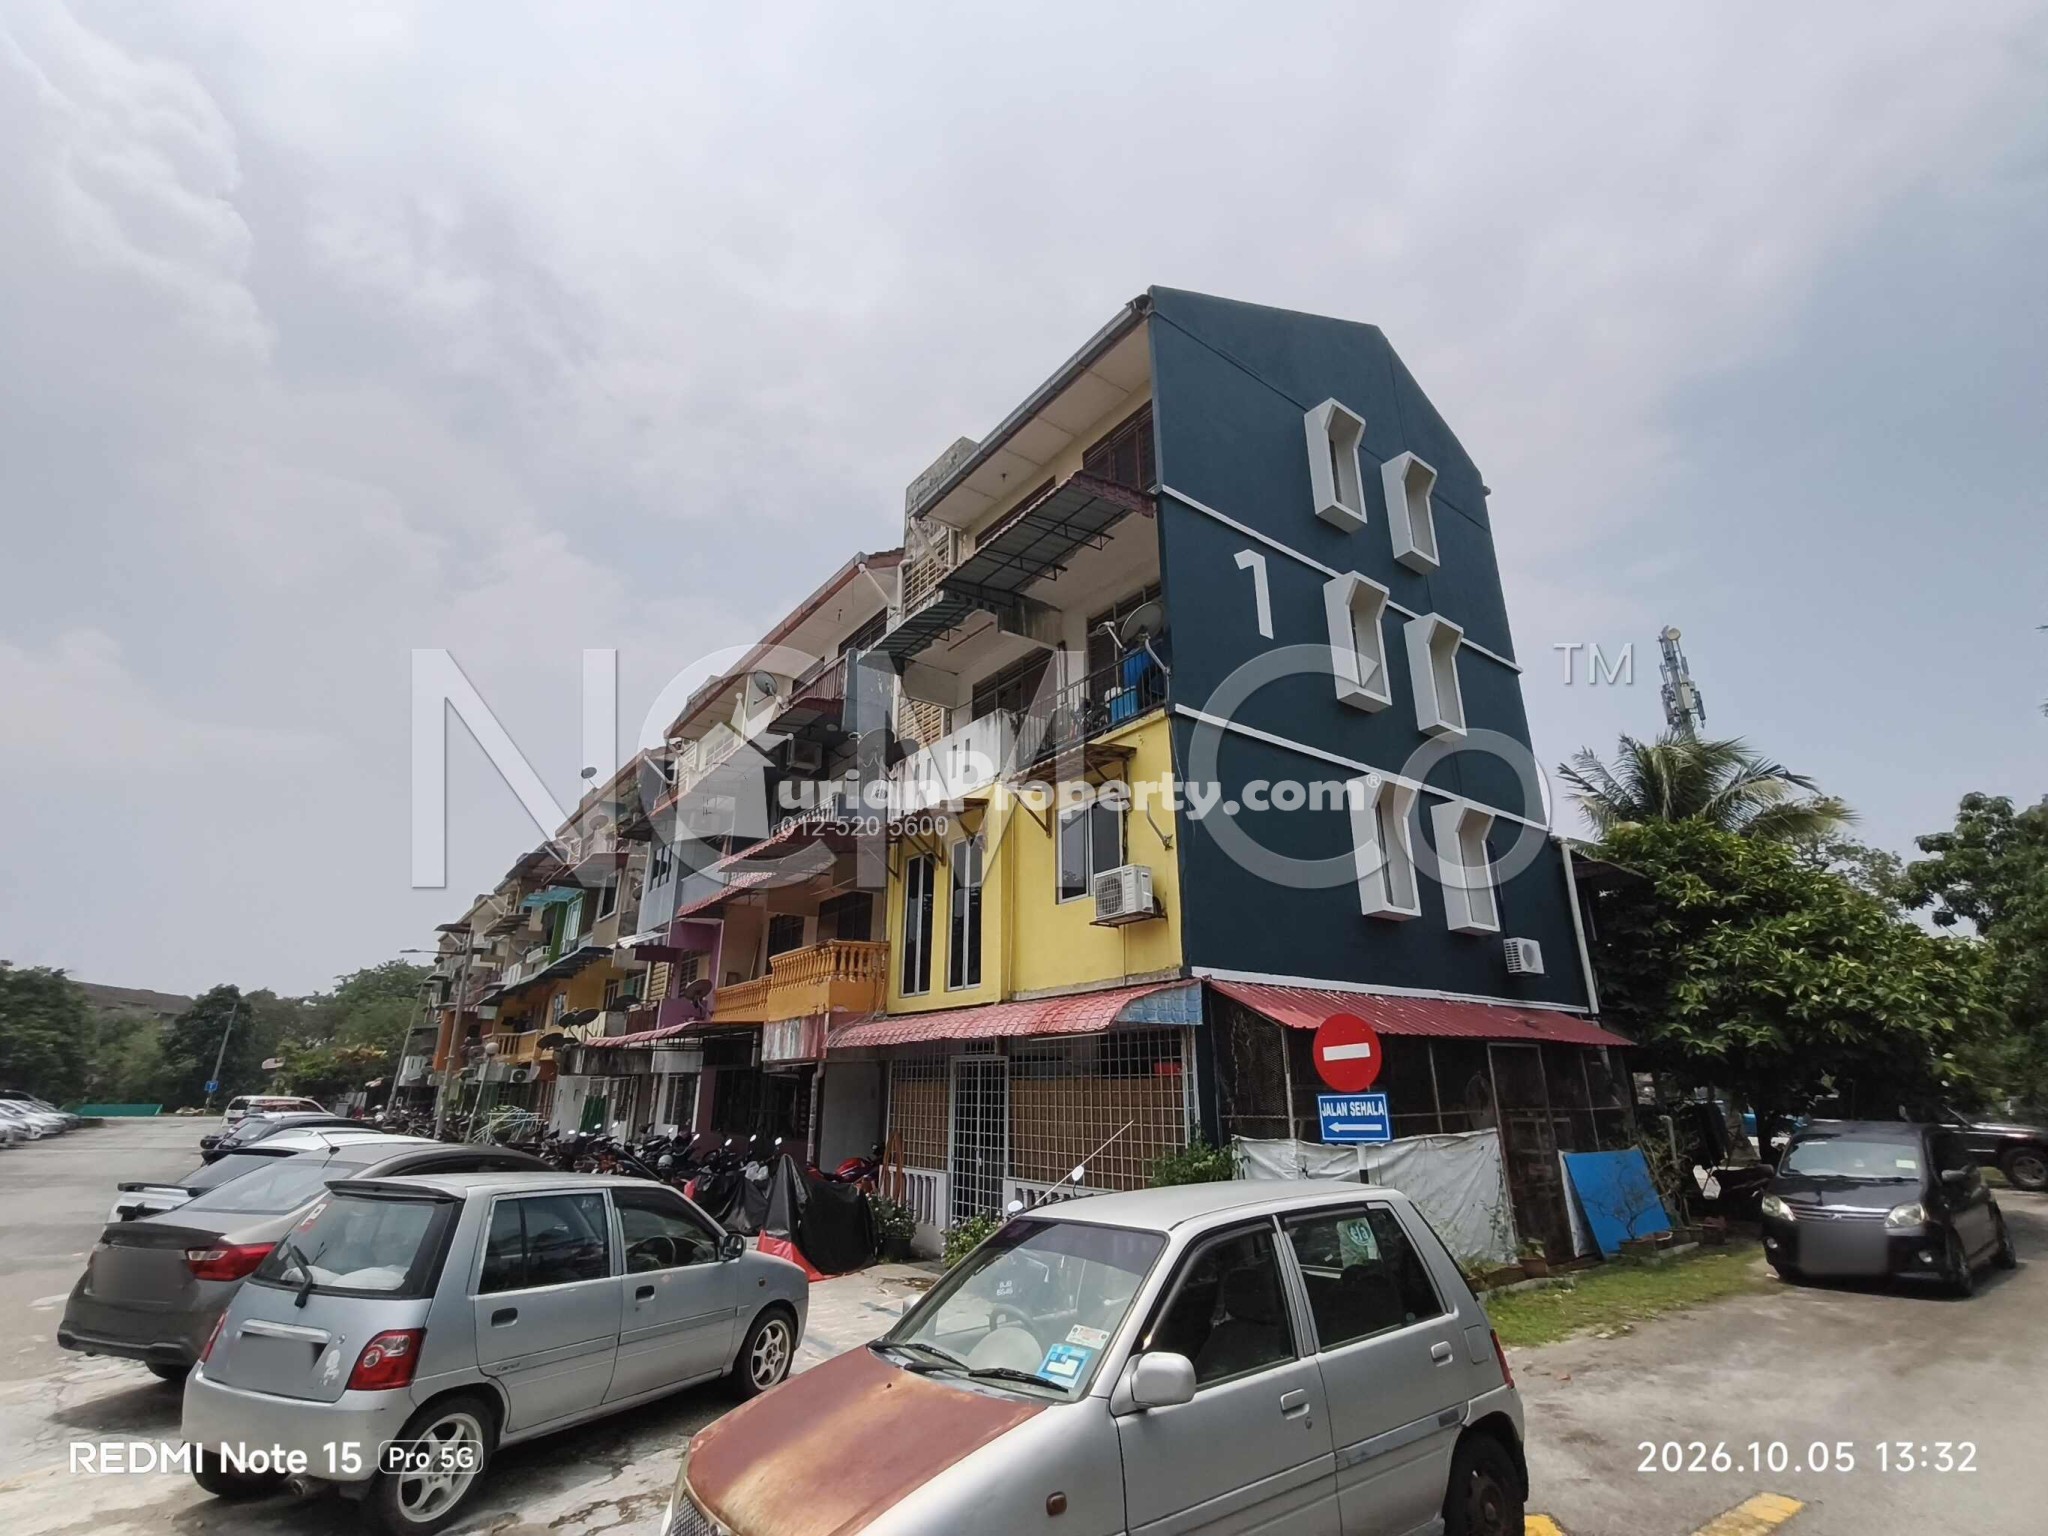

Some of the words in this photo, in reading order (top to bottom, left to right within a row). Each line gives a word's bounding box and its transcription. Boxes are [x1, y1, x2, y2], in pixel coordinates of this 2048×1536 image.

[1233, 548, 1274, 640] 1
[1321, 1102, 1348, 1117] JALAN
[1349, 1100, 1385, 1117] SEHALA
